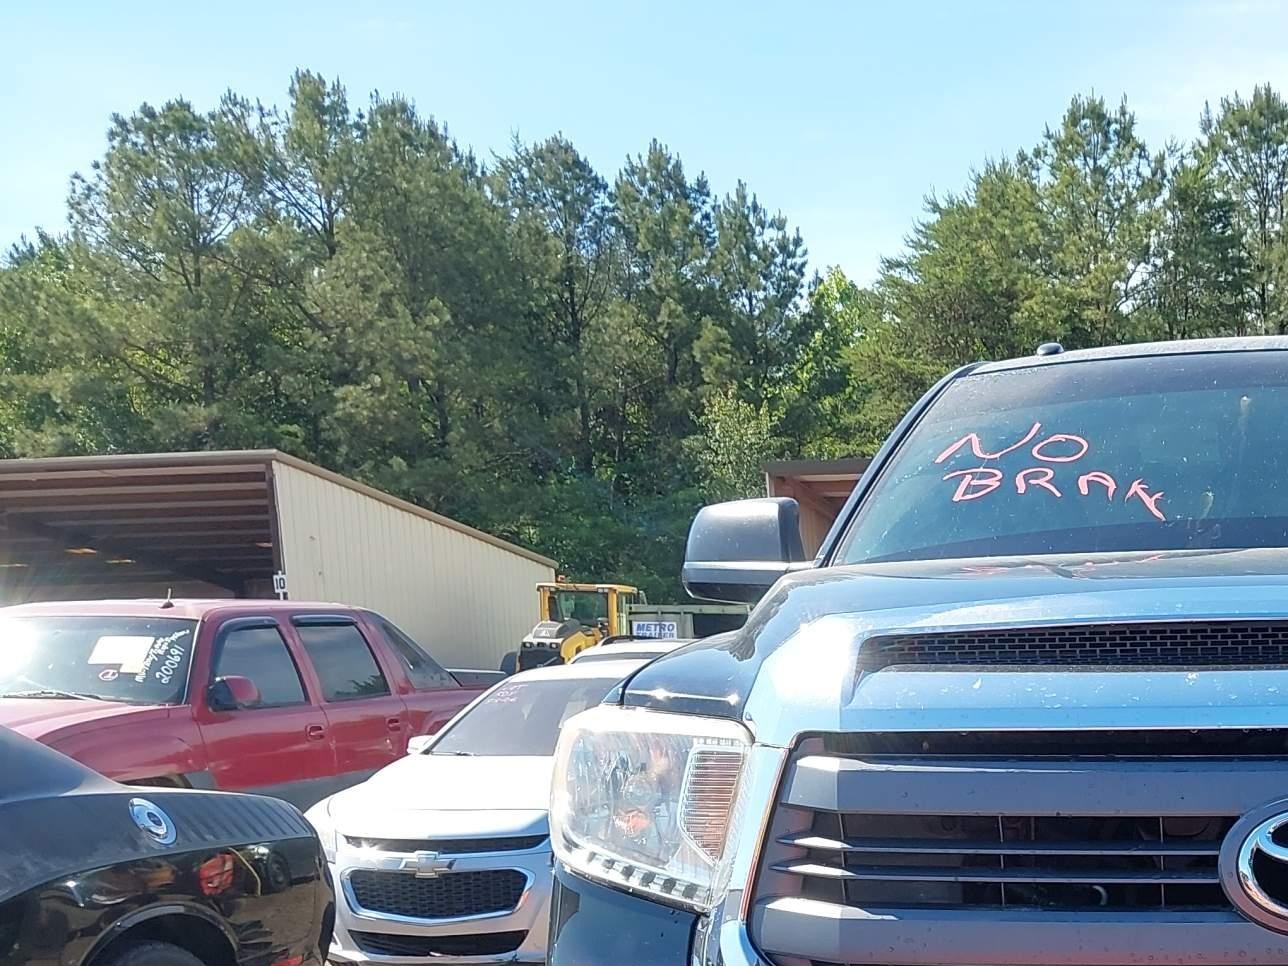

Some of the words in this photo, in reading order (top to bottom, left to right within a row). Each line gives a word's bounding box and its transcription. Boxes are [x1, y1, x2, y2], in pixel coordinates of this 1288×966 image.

[934, 422, 1089, 464] NO
[275, 577, 286, 590] 10
[636, 623, 675, 632] METRO
[155, 644, 185, 684] 200691
